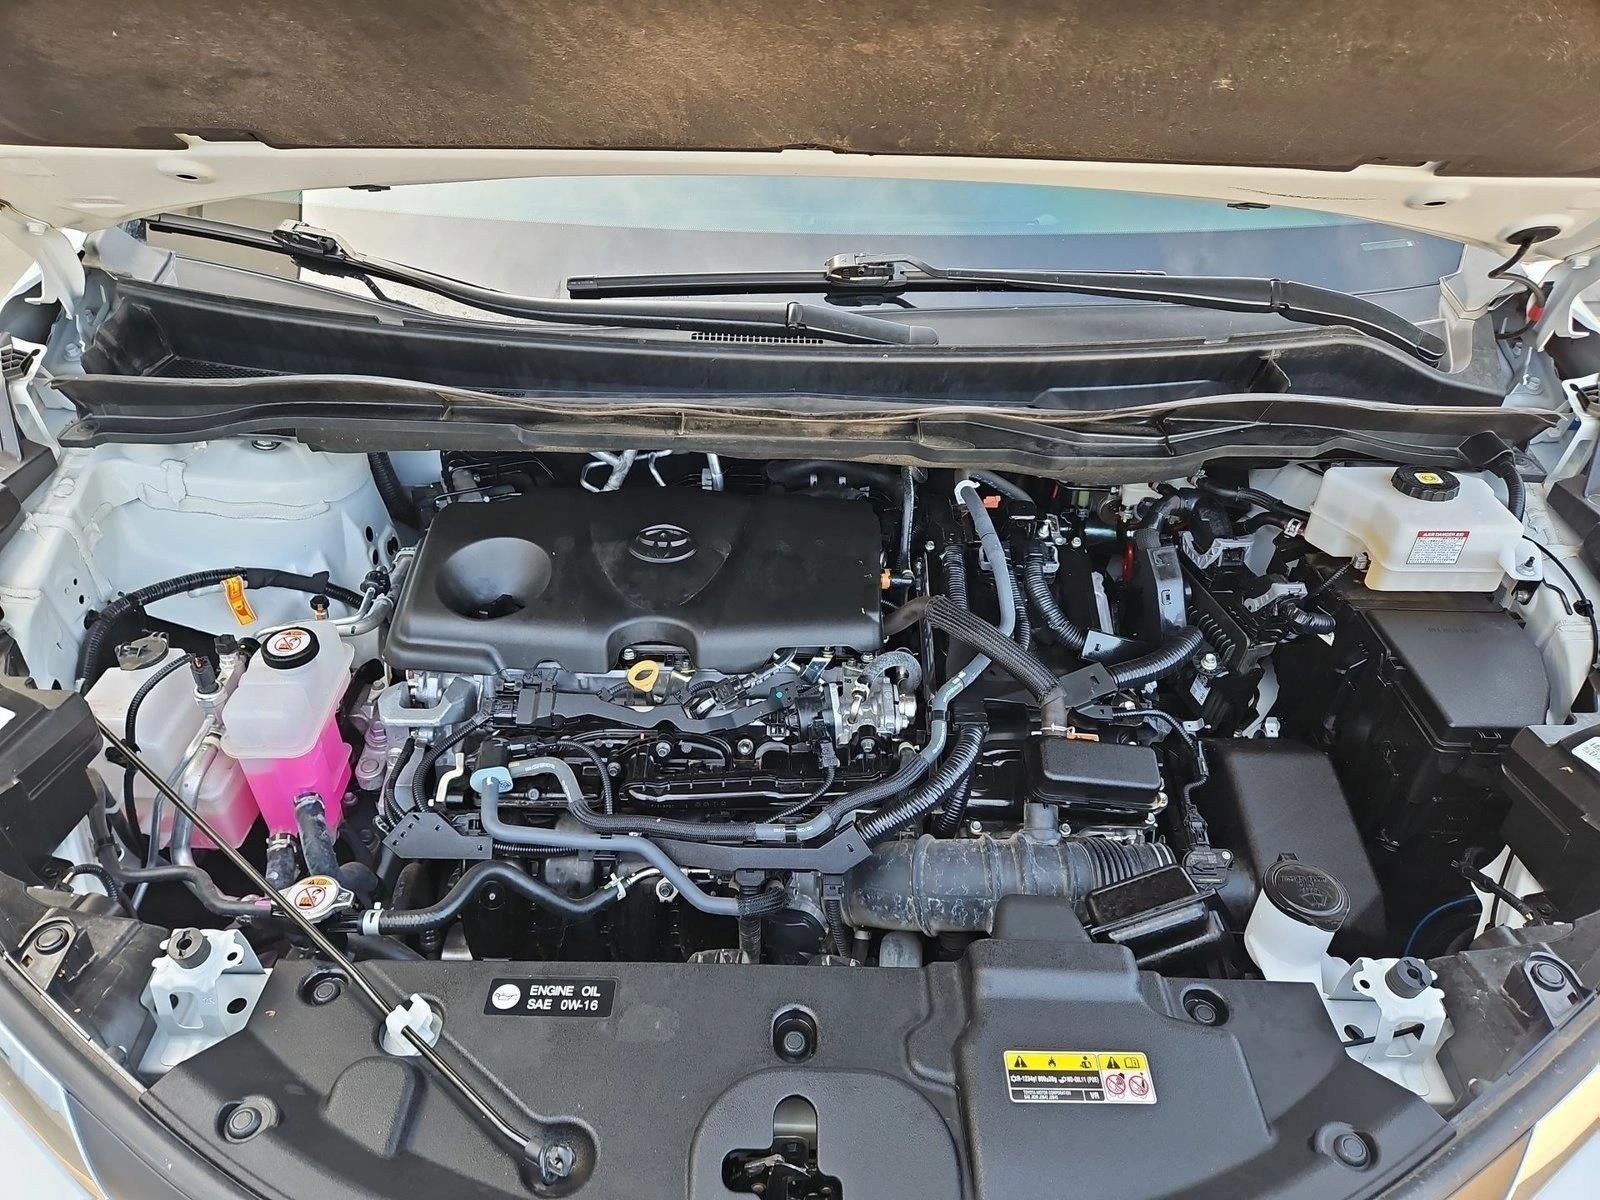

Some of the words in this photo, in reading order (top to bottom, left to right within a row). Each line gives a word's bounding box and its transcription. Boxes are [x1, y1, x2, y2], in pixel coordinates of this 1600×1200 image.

[529, 985, 574, 997] ENGINE
[581, 986, 601, 997] OIL
[526, 999, 552, 1010] SAE
[560, 1000, 599, 1011] 0W-16
